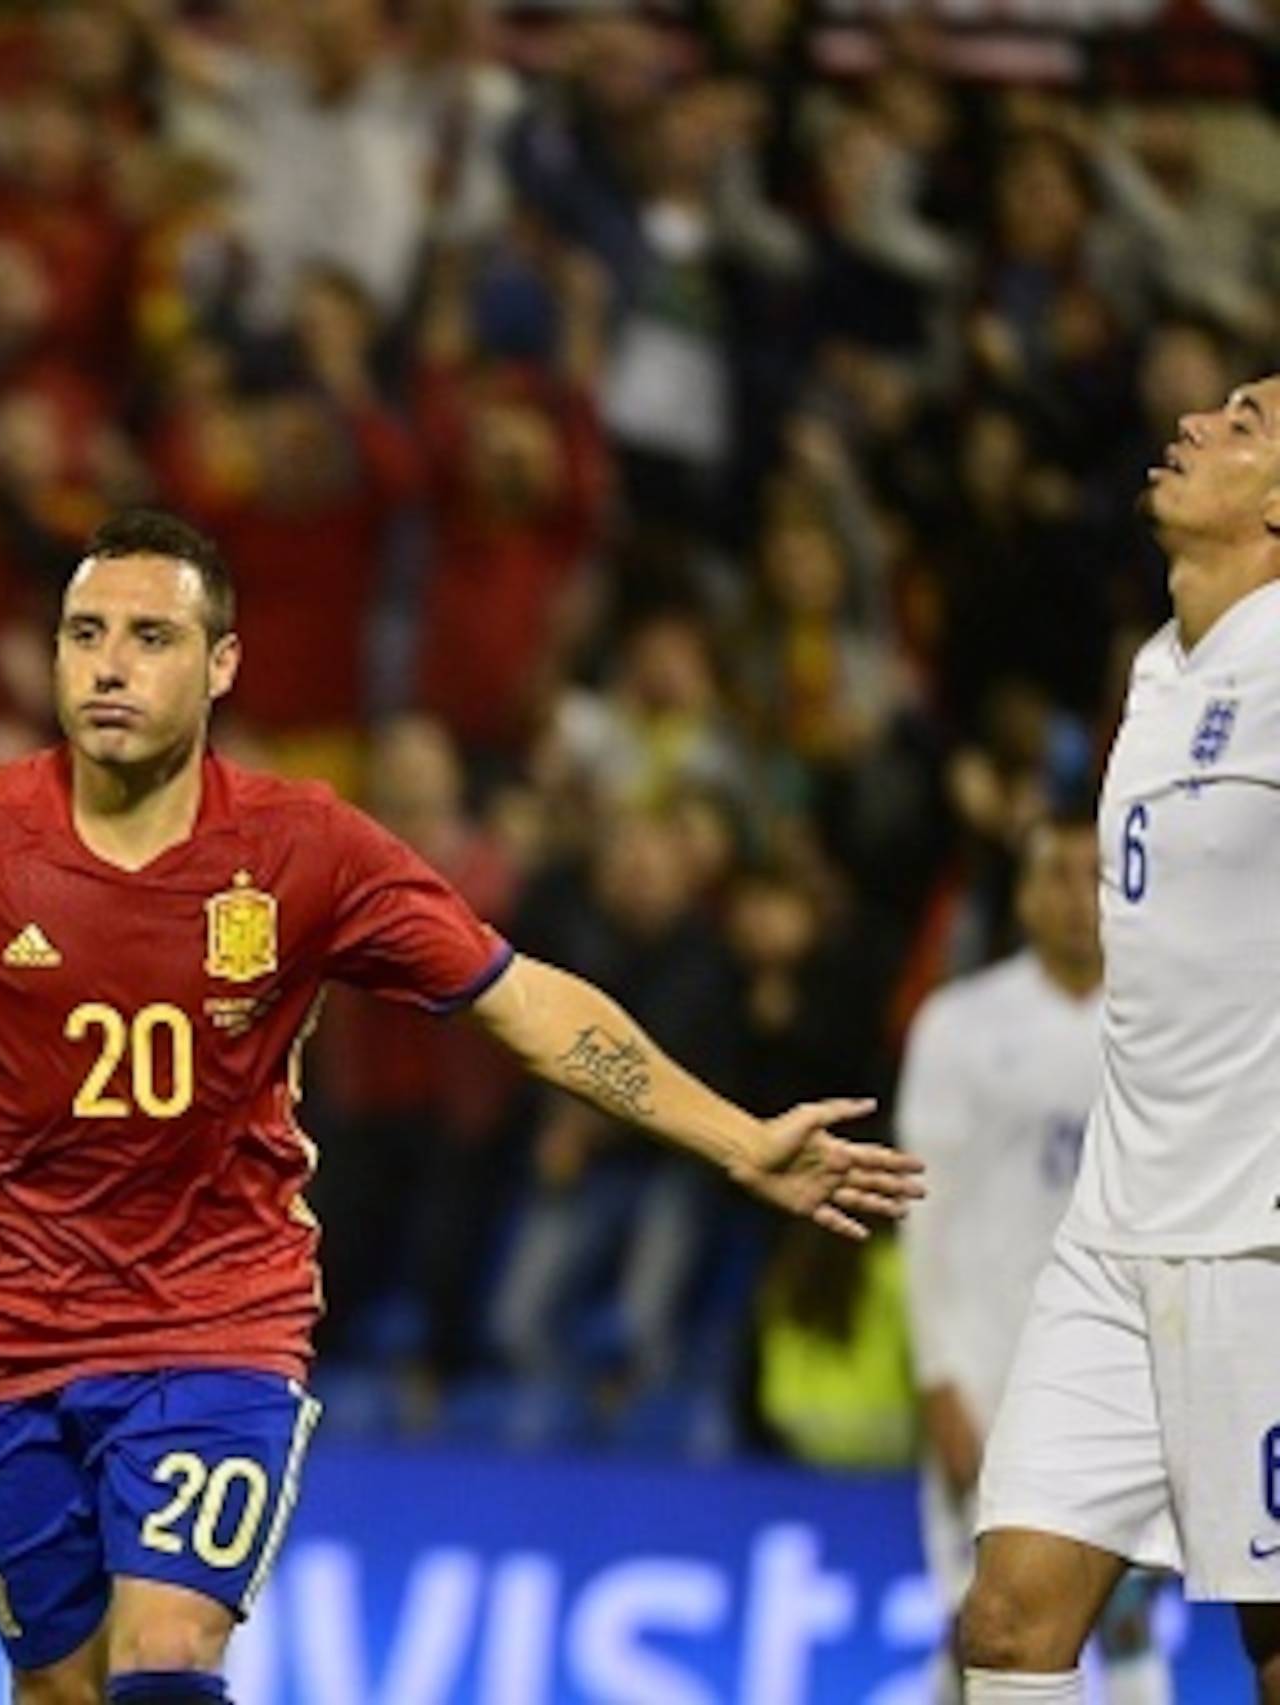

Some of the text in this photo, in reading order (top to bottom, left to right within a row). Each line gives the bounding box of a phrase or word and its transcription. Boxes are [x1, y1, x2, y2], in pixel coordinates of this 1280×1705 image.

[1124, 802, 1149, 904] 6
[63, 1001, 195, 1120] 20
[140, 1451, 269, 1569] 20
